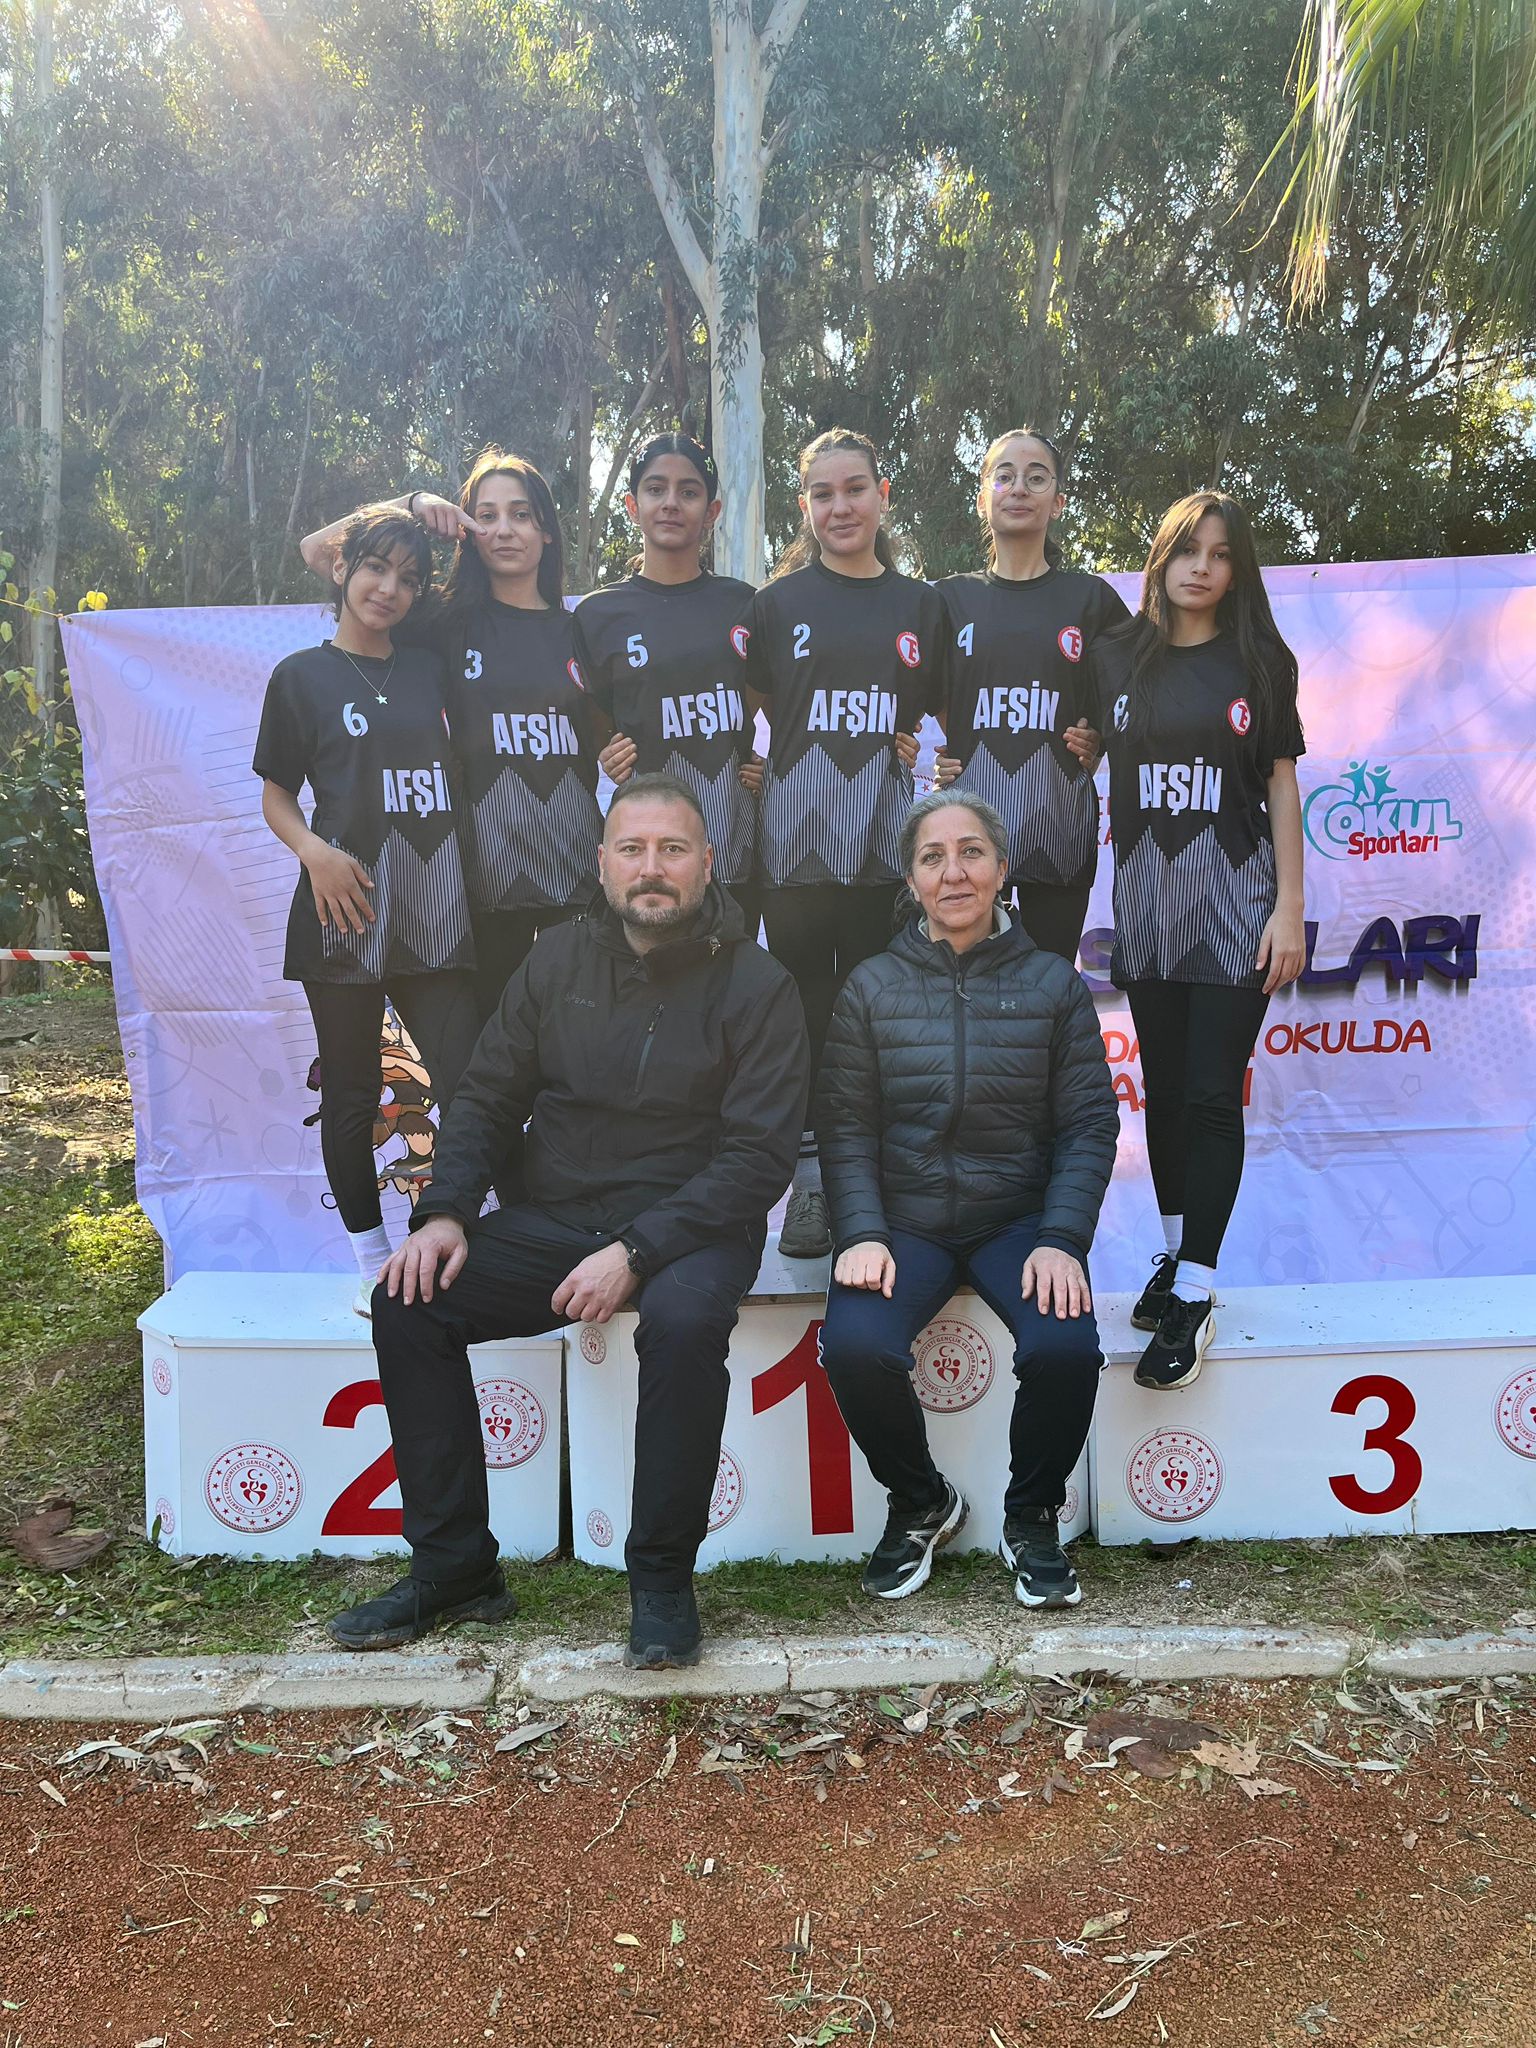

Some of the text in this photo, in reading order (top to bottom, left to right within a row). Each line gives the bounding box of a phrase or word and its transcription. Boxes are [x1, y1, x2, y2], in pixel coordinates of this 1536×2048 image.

[464, 648, 483, 680] 3
[627, 633, 649, 668] 5
[793, 623, 811, 660] 2
[957, 622, 974, 657] 4
[342, 702, 369, 737] 6
[492, 706, 579, 761] AFŞİN
[661, 682, 744, 741] AFŞİN
[807, 684, 898, 738] AFŞİN
[973, 680, 1060, 734] AFŞİN
[382, 761, 452, 818] AFŞİ
[1138, 756, 1223, 816] AFŞİN
[1324, 799, 1463, 845] OKUL
[1347, 830, 1439, 861] Sporları
[1264, 1019, 1432, 1056] OKULDA
[751, 1319, 855, 1536] 1
[1328, 1374, 1423, 1515] 3
[321, 1379, 405, 1537] 2
